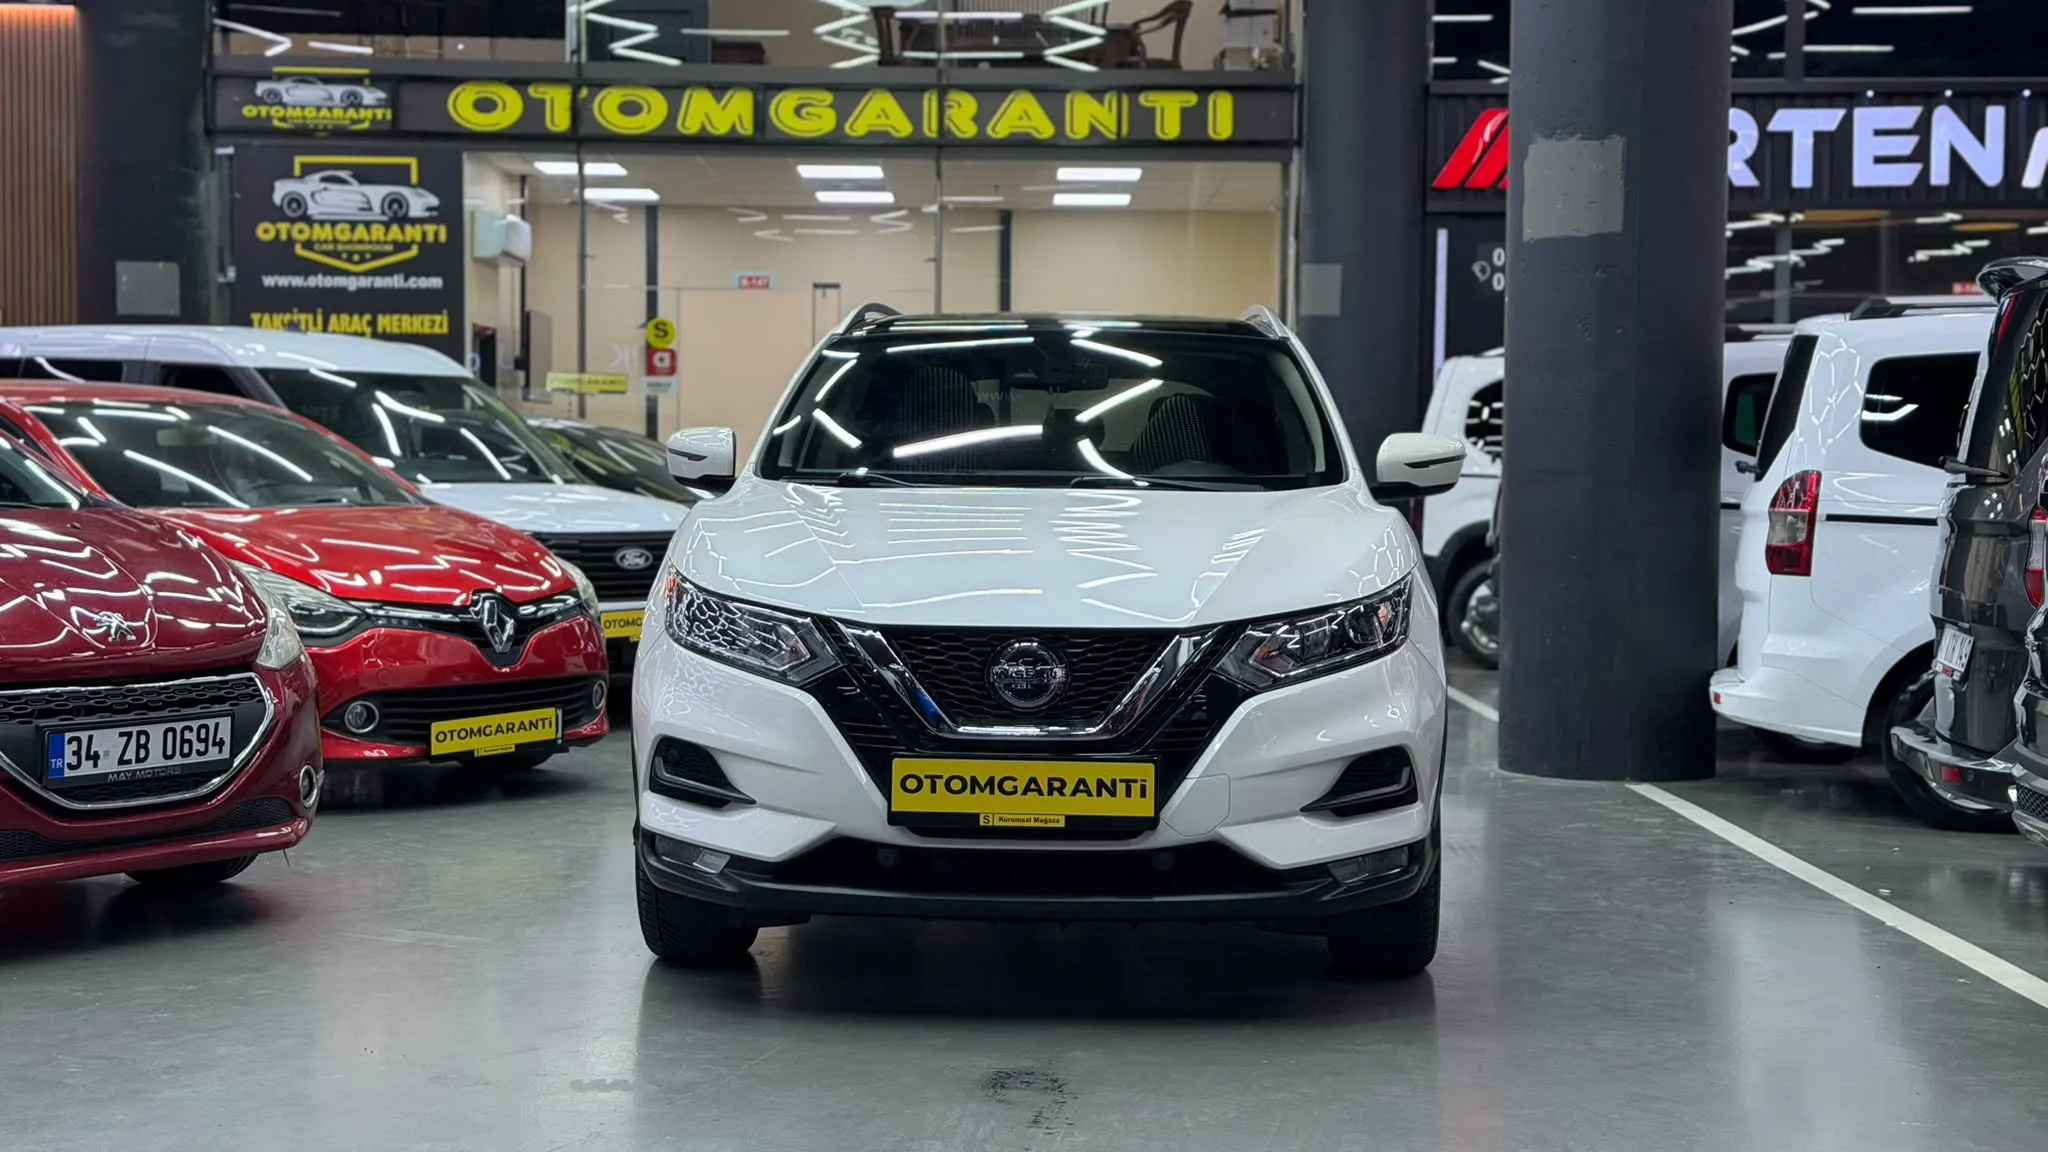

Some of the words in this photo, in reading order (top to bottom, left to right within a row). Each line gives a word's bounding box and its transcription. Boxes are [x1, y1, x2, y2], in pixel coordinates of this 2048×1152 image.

[242, 104, 393, 121] OTOMGARANTI
[447, 80, 1234, 141] OTOMGARANTI
[1728, 105, 2048, 188] RTEN
[256, 222, 447, 243] OTOMGARANTI
[262, 273, 443, 291] www.otomgaranti.com
[328, 313, 373, 339] ARAÇ
[377, 308, 449, 334] MERKEZİ
[654, 321, 669, 339] S
[66, 734, 101, 771] 34
[117, 729, 151, 766] ZB
[162, 722, 225, 761] 0694
[50, 757, 63, 769] TR
[107, 771, 132, 782] MAY
[135, 766, 182, 778] MOTORS
[998, 816, 1031, 824] Kurumsal
